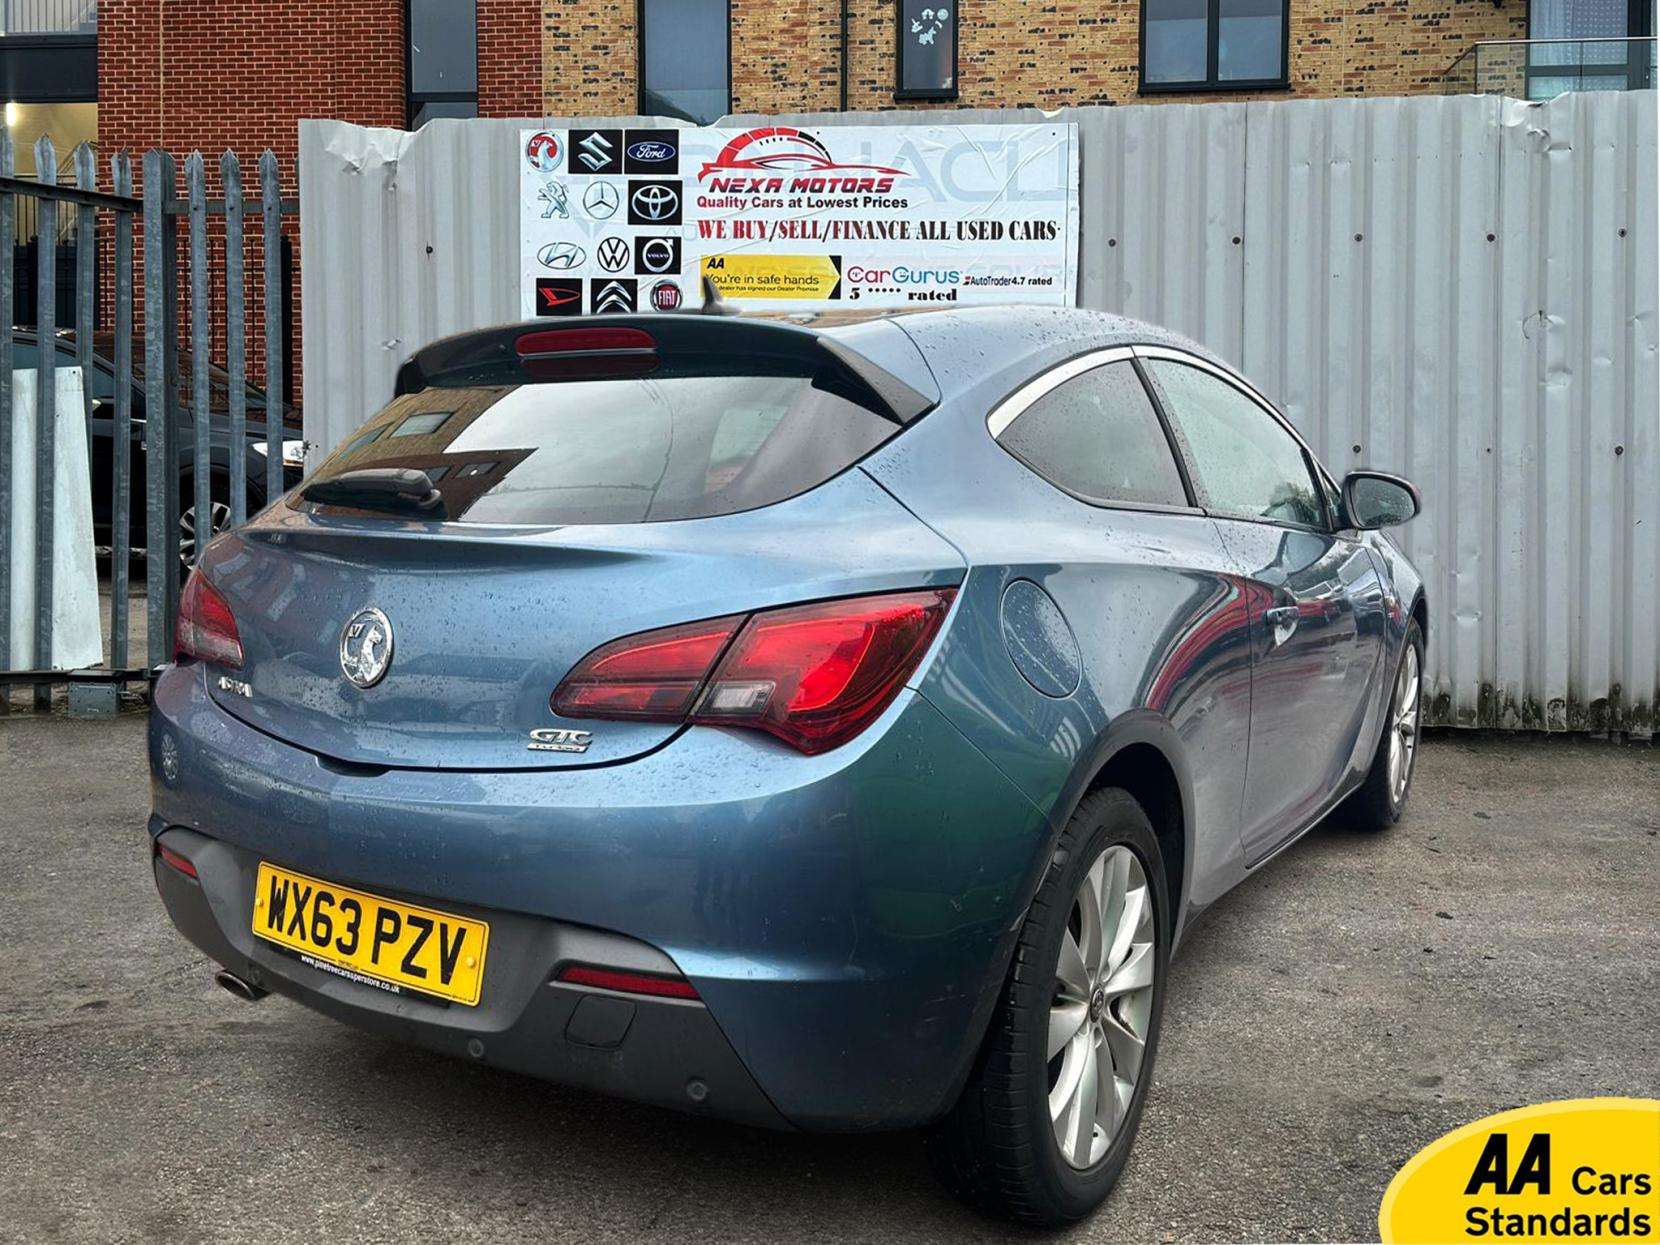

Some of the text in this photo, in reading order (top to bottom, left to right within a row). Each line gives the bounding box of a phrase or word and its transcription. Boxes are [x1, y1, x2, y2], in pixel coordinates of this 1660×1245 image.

[637, 144, 666, 158] Ford
[709, 178, 895, 193] NEXA MOTORS
[697, 196, 908, 209] Quality Cars at Lowest Prices
[698, 220, 1057, 242] WE BUY/SELL/FINANCE ALL USED CARS
[707, 258, 725, 269] AA
[744, 275, 754, 284] in
[757, 274, 781, 284] safe
[784, 274, 820, 285] hands
[847, 266, 960, 284] CarGurus
[1028, 277, 1053, 285] rated
[658, 290, 677, 305] FIAT
[849, 287, 957, 301] 5 rated
[268, 876, 467, 986] WX63 PZV
